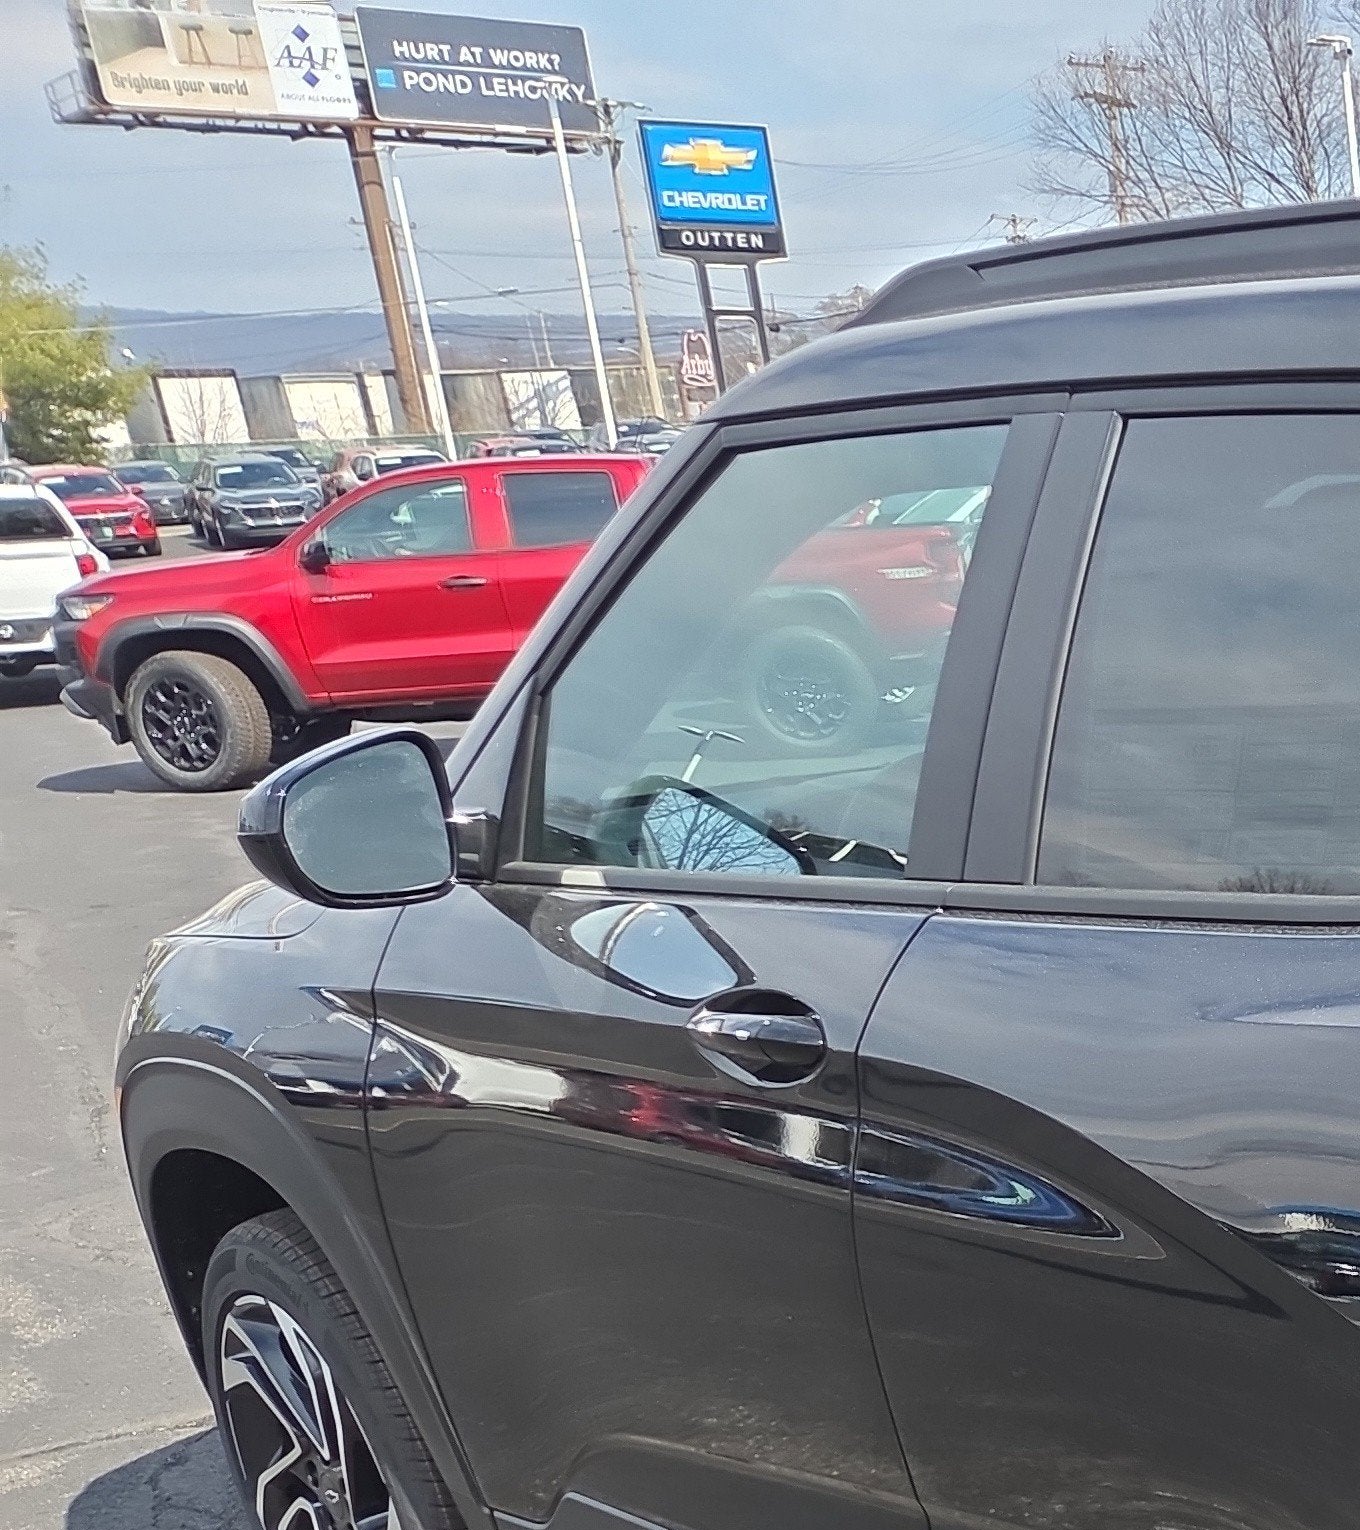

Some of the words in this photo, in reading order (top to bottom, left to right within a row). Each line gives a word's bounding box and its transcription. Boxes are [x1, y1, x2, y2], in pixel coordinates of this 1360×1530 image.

[274, 44, 338, 71] AAF
[392, 40, 451, 62] HURT
[459, 46, 483, 64] AT
[488, 49, 561, 71] WORK?
[110, 71, 171, 94] Brighten
[173, 77, 204, 96] your
[210, 78, 249, 96] world
[403, 69, 473, 94] POND
[662, 190, 768, 211] CHEVROLET
[681, 230, 764, 249] OUTTEN
